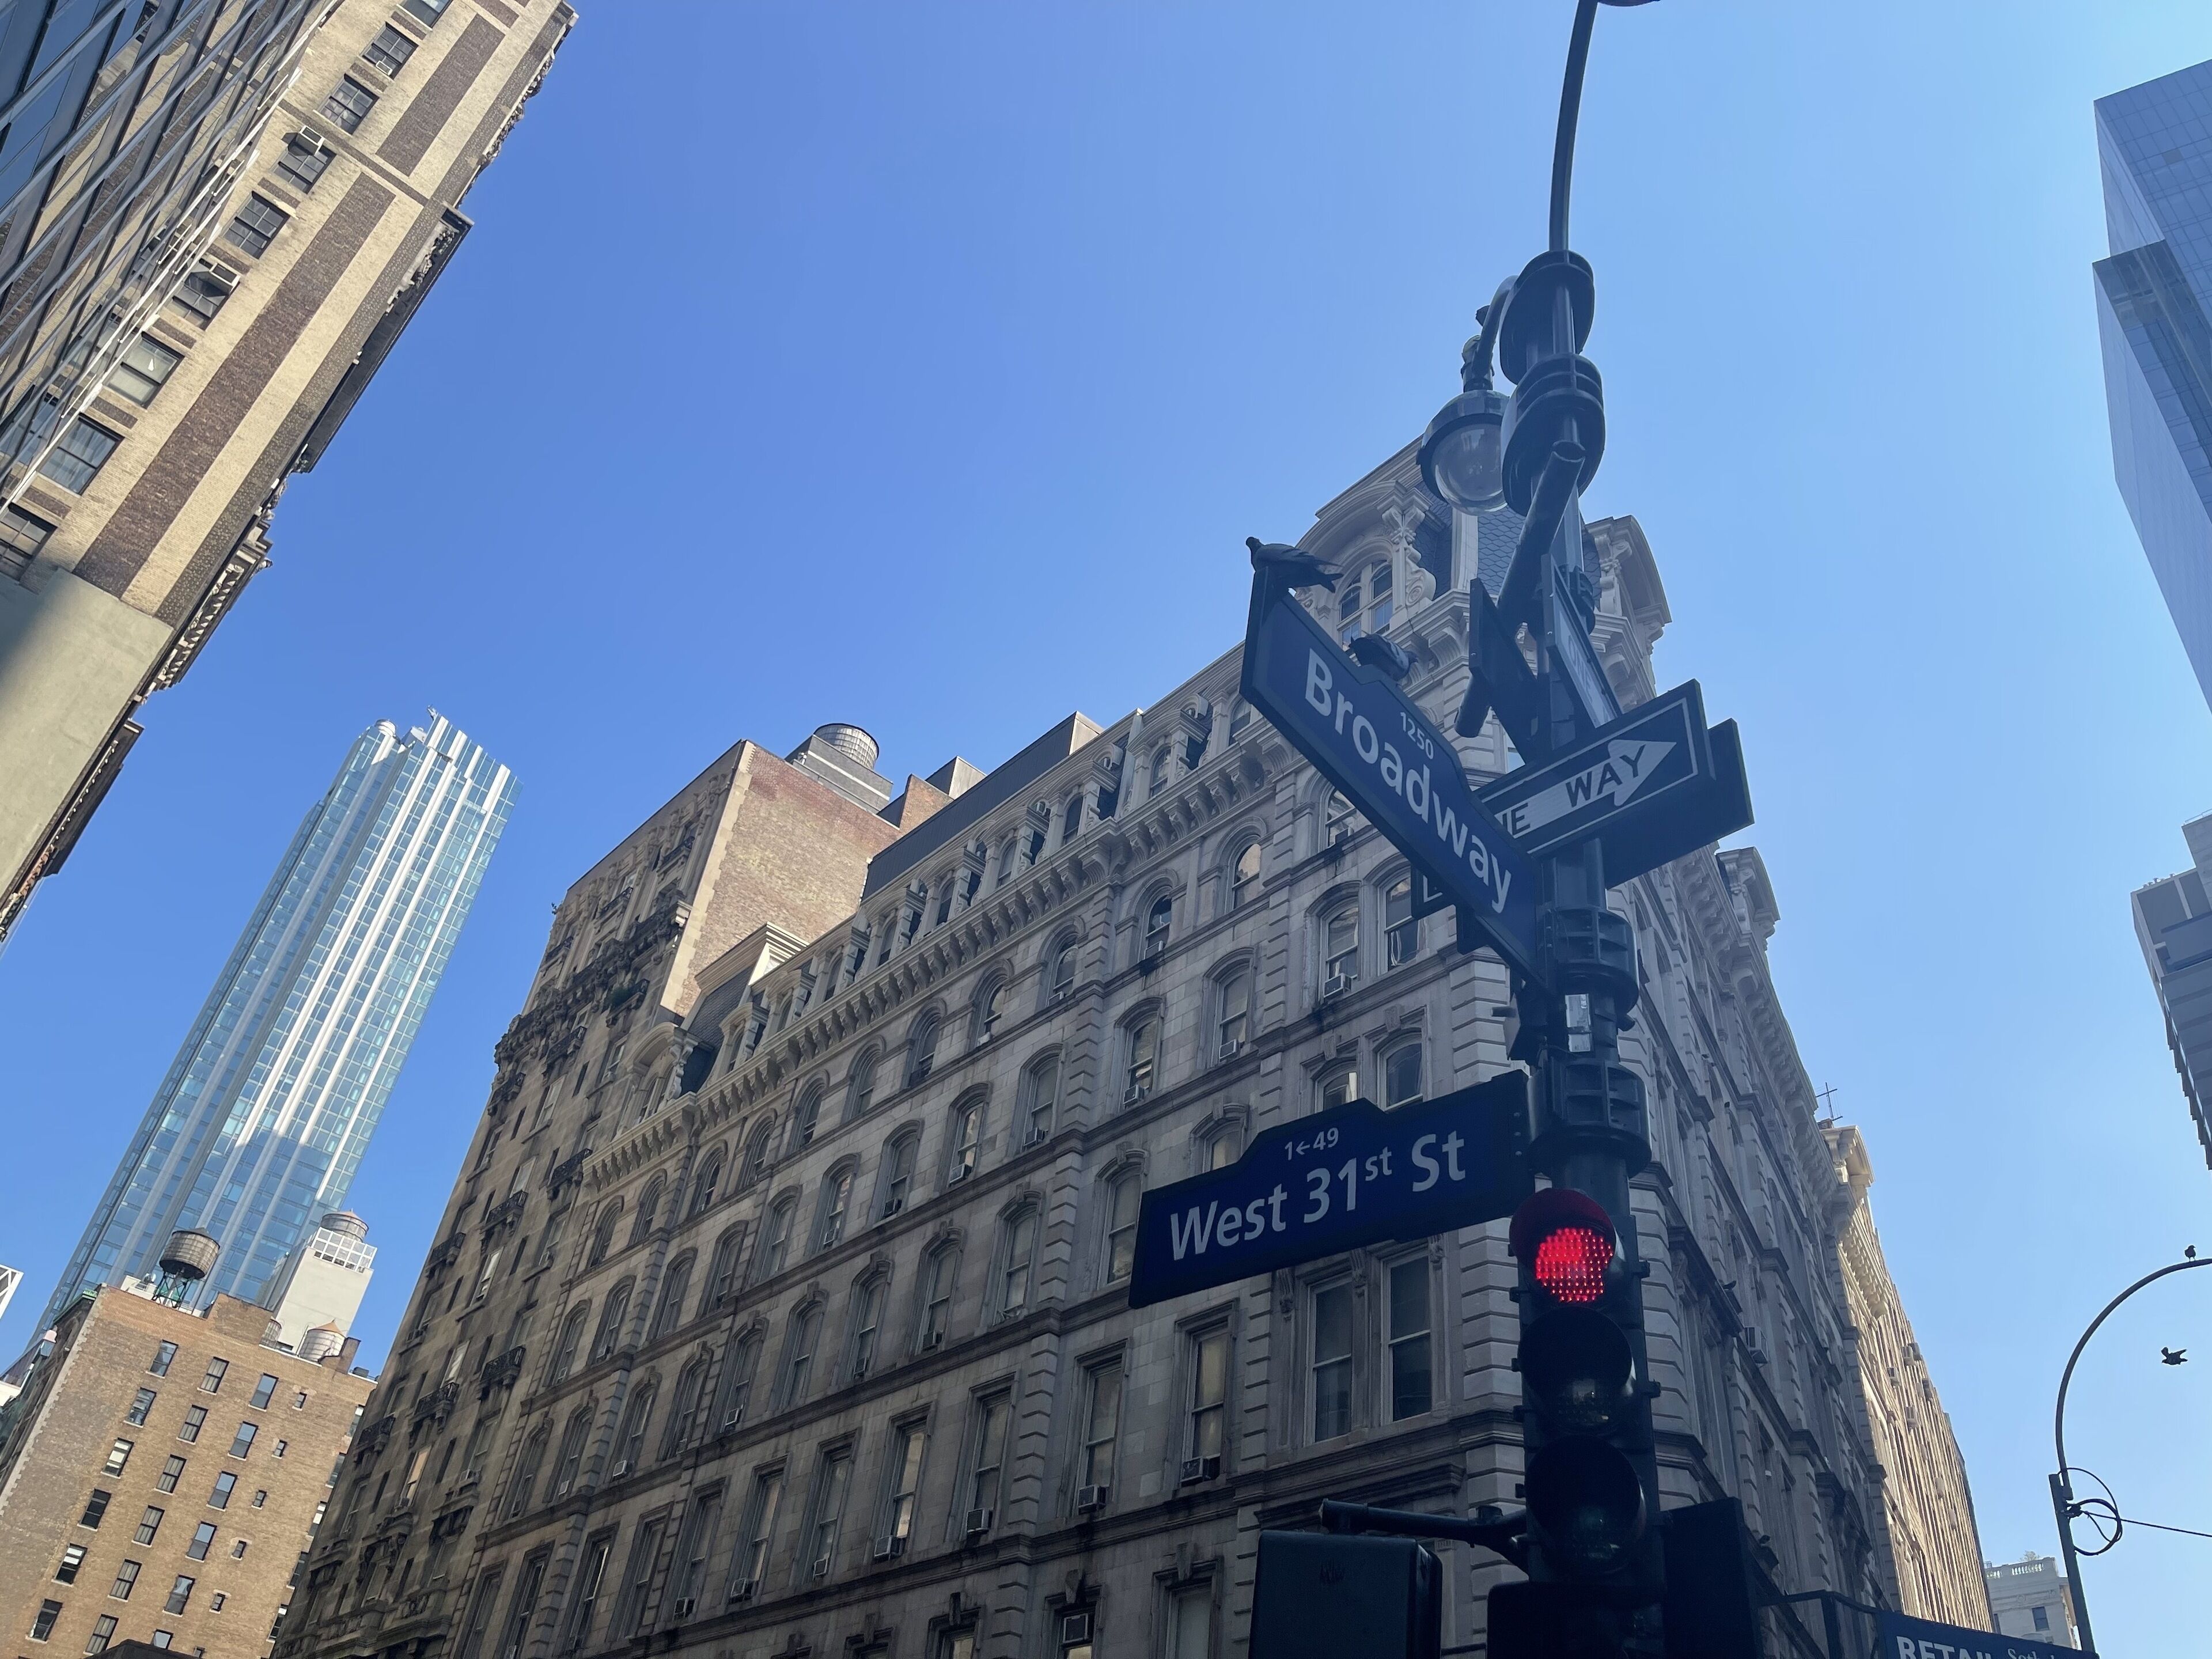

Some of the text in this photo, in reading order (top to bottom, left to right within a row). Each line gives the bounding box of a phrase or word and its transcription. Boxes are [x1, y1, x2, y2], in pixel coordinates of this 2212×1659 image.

[1305, 648, 1512, 914] Broadway
[1400, 711, 1434, 760] 1250
[1565, 744, 1646, 808] WAY
[1170, 1130, 1466, 1260] West 31st St
